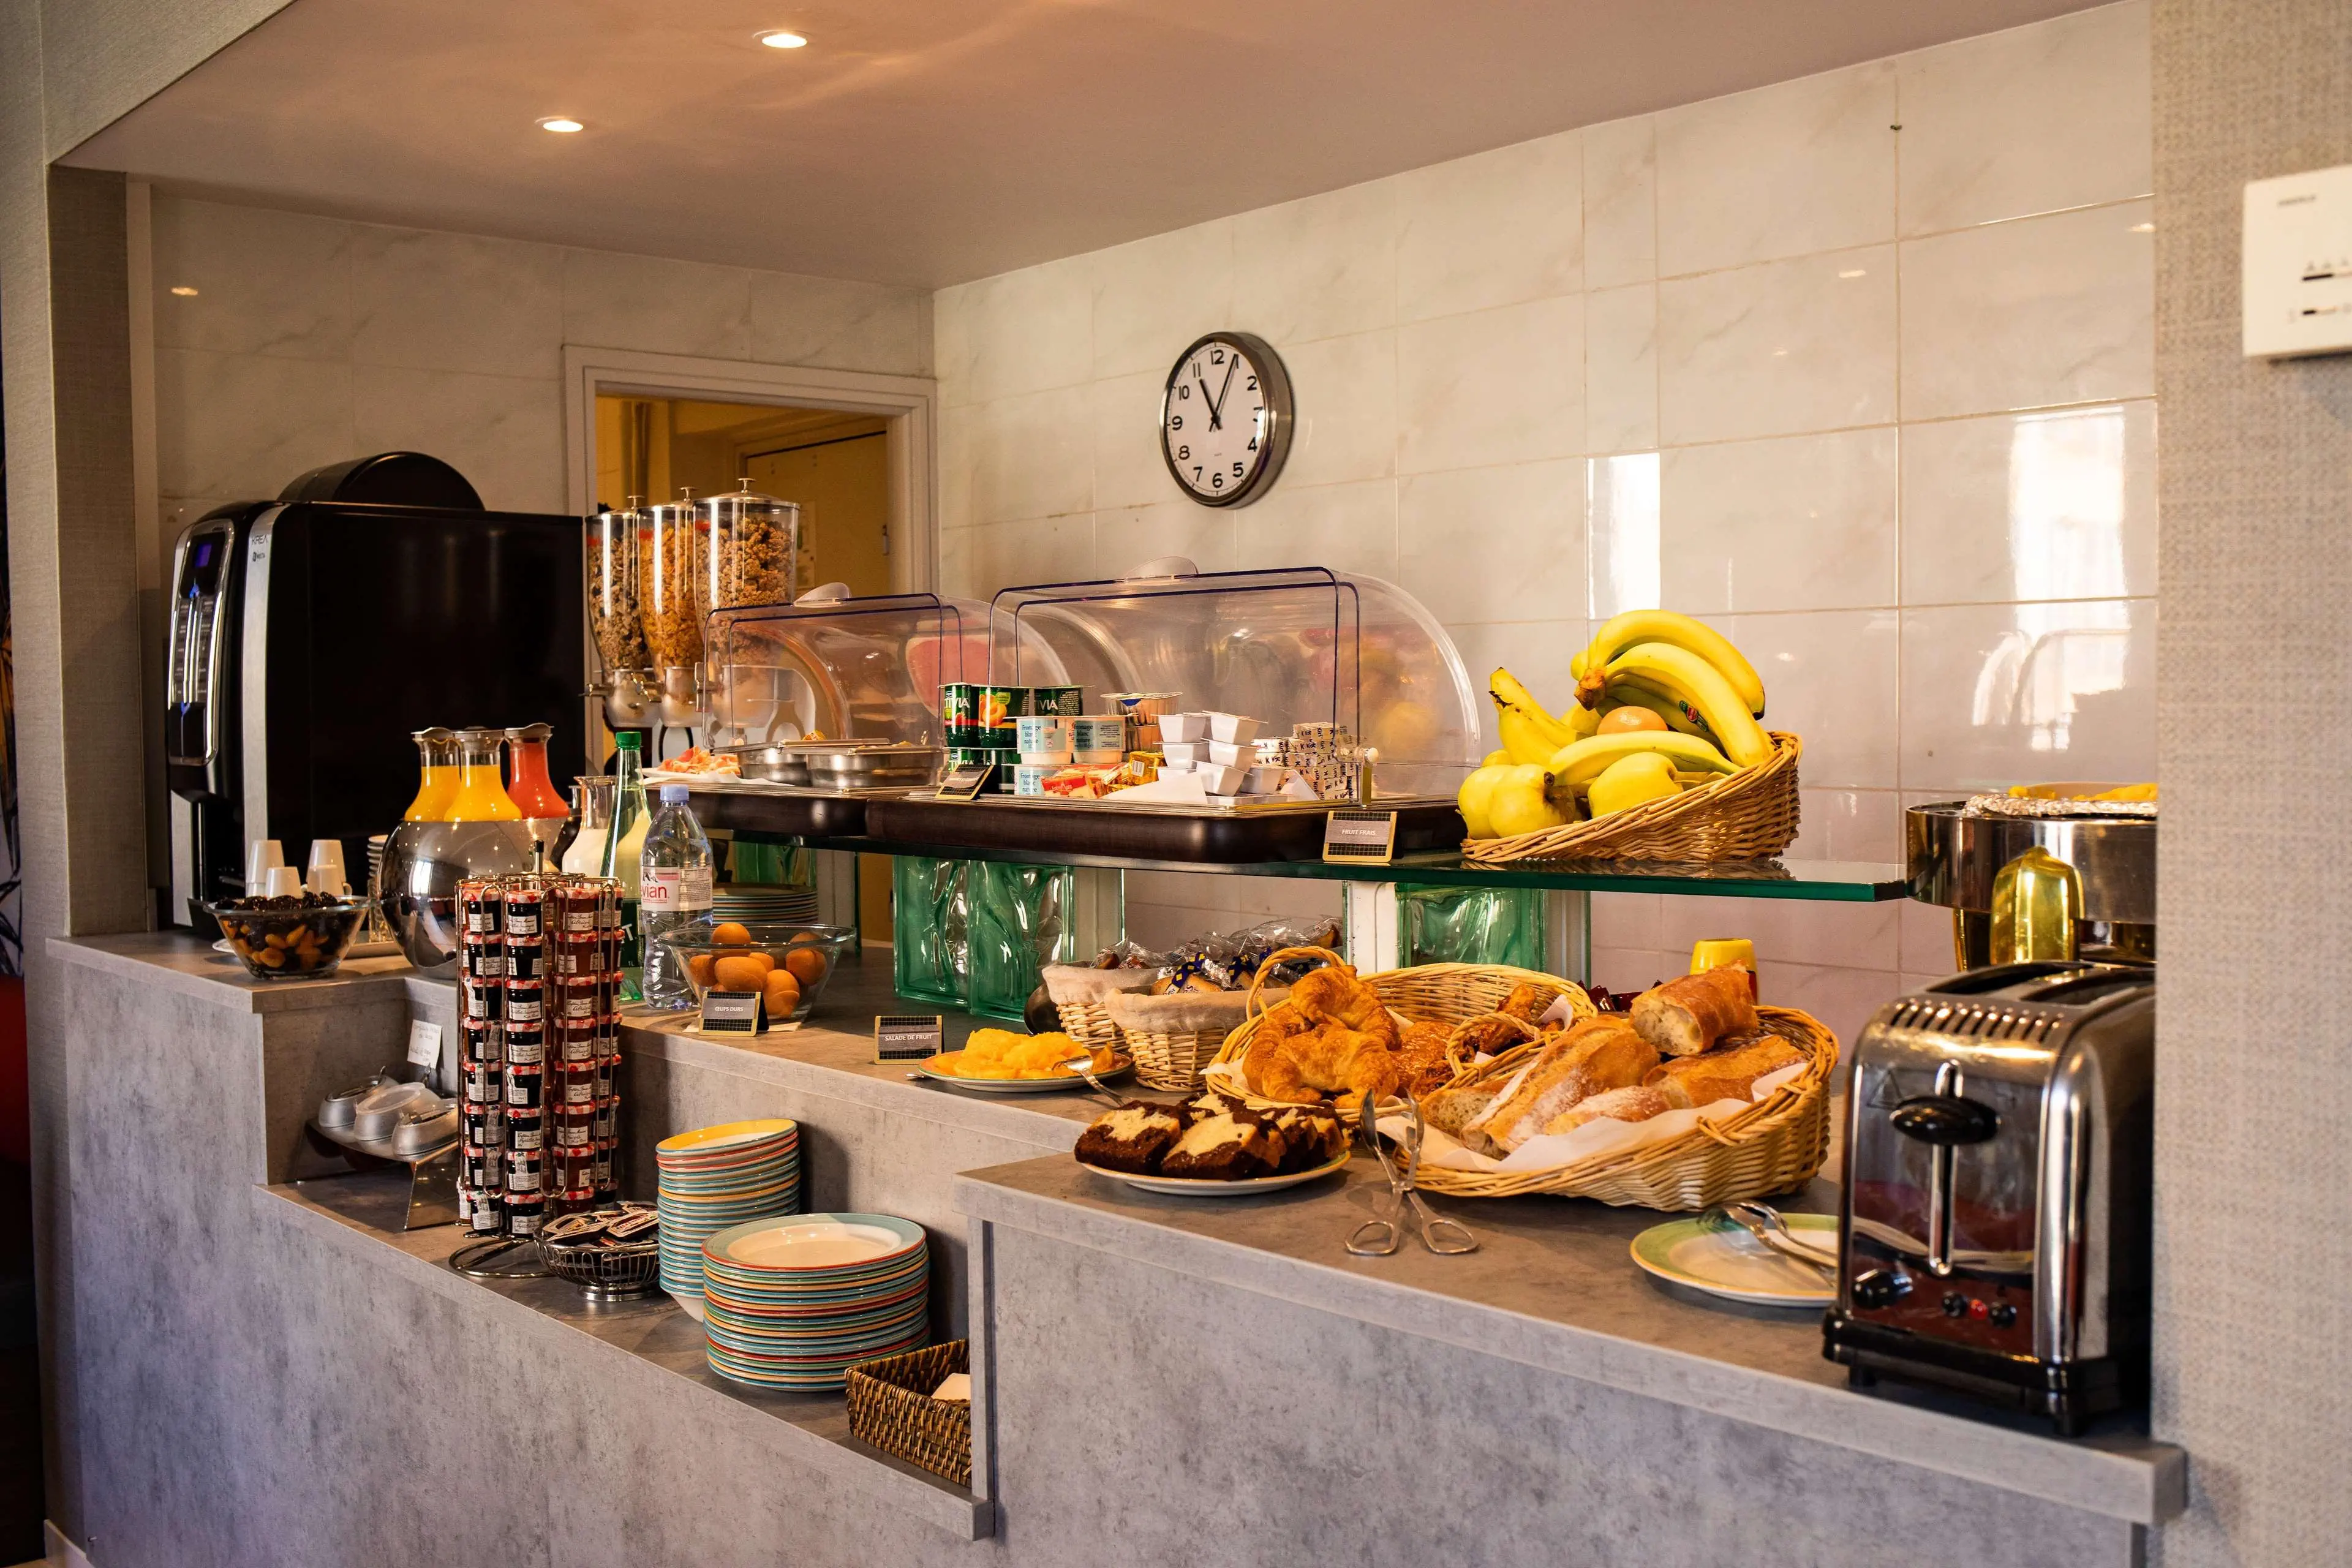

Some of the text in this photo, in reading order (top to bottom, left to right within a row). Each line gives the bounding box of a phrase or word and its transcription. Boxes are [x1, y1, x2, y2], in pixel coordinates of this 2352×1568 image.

[1210, 349, 1224, 365] 12
[1193, 363, 1201, 378] 11
[1247, 375, 1257, 391] 2
[1178, 385, 1189, 400] 10
[1172, 416, 1182, 430] 9
[1248, 437, 1257, 451] 4
[1178, 445, 1189, 460] 8
[1193, 466, 1202, 481] 7
[1233, 462, 1243, 477] 5
[1213, 473, 1223, 488] 6
